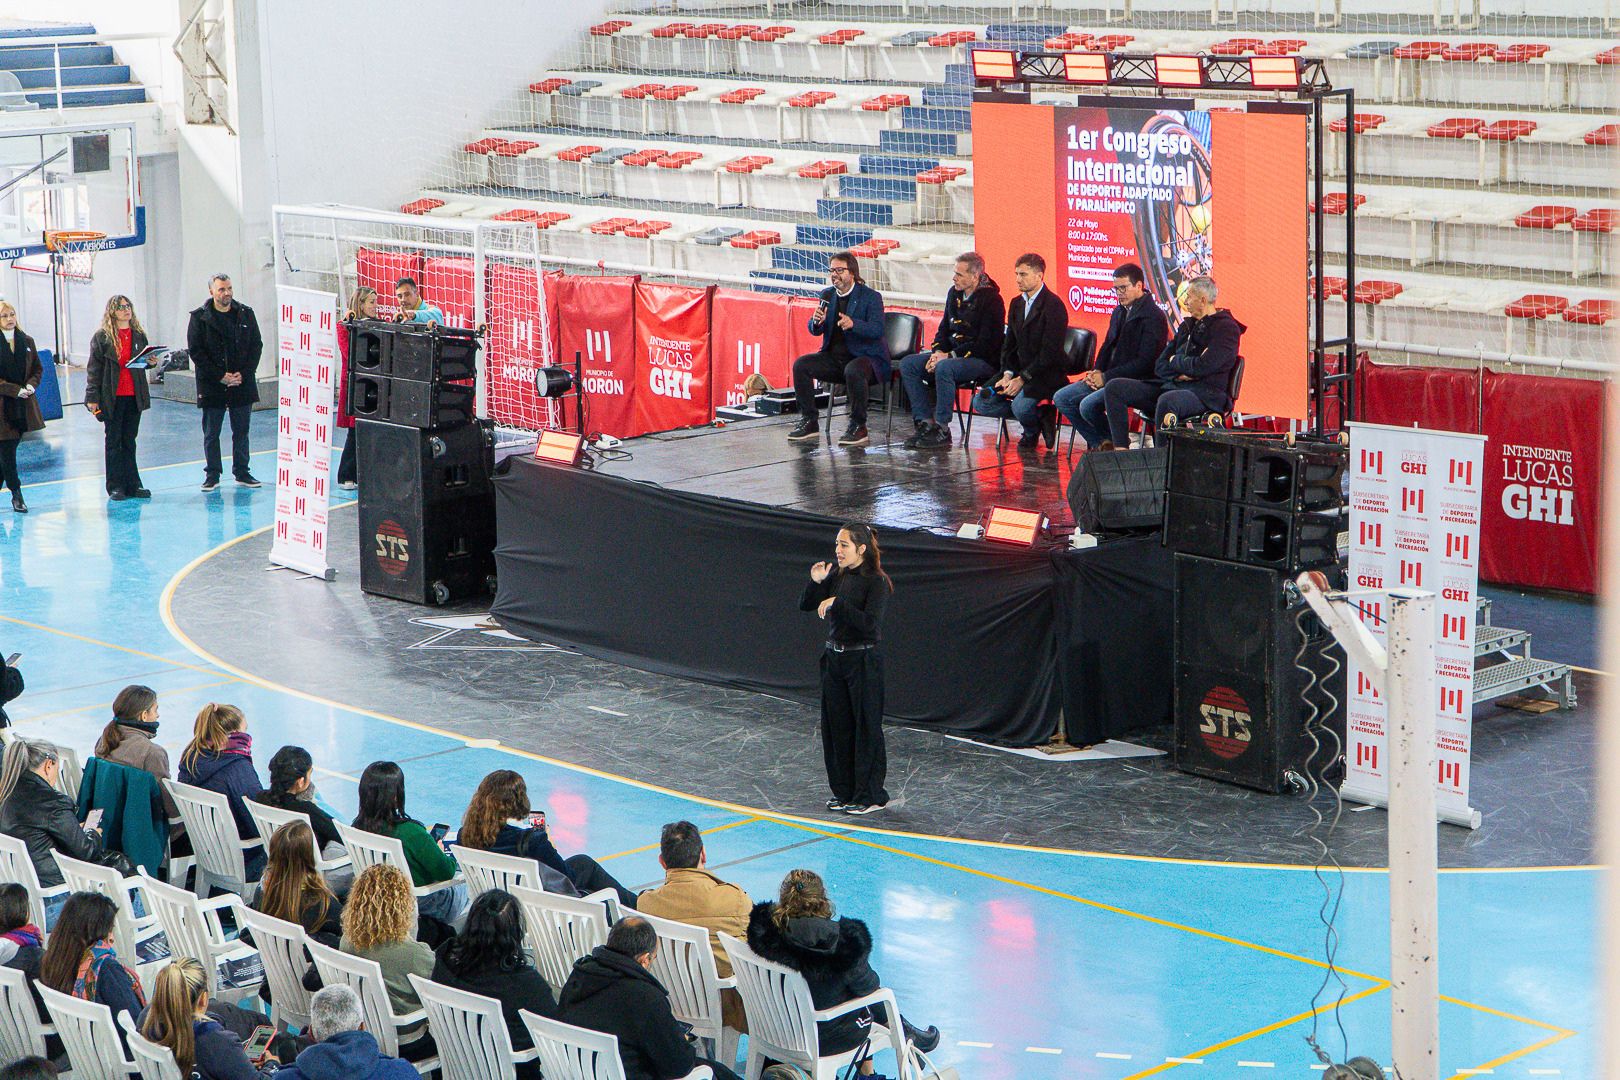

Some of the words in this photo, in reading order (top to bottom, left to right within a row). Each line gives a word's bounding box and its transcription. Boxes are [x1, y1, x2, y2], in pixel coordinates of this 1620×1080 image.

[1067, 125, 1098, 150] 1er
[1103, 126, 1191, 159] Congreso
[1067, 156, 1193, 186] Internacional
[1067, 183, 1079, 195] DE
[1081, 183, 1121, 198] DEPORTE
[1123, 186, 1172, 201] ADAPTADO
[1067, 198, 1074, 210] Y
[1076, 198, 1136, 214] PARALÍMPICO
[1068, 218, 1075, 227] 22
[1076, 219, 1083, 228] de
[1084, 220, 1098, 230] Mayo
[1068, 230, 1080, 240] 8:00
[1068, 243, 1094, 253] Organizado
[1109, 246, 1124, 255] COPAR
[1124, 249, 1129, 257] y
[1068, 253, 1090, 263] Municipio
[1083, 296, 1118, 306] Microestadio
[1084, 305, 1092, 313] Blas
[649, 335, 691, 351] INTENDENTE
[648, 347, 693, 370] LUCAS
[586, 369, 607, 377] MUNICIPIO
[649, 367, 693, 400] GHI
[280, 397, 291, 407] GHI
[1502, 444, 1572, 463] INTENDENTE
[1401, 462, 1427, 475] GHI
[1502, 458, 1573, 487] LUCAS
[296, 478, 307, 488] GHI
[1363, 499, 1385, 507] DEPORTE
[1501, 483, 1574, 525] GHI
[1450, 510, 1474, 518] DEPORTE
[376, 533, 409, 562] STS
[1403, 537, 1426, 545] DEPORTE
[1357, 575, 1383, 589] GHI
[1442, 588, 1469, 602] GHI
[1443, 664, 1468, 673] DEPORTE
[1200, 703, 1252, 742] STS
[1359, 720, 1381, 729] DEPORTE
[1441, 737, 1464, 746] DEPORTE
